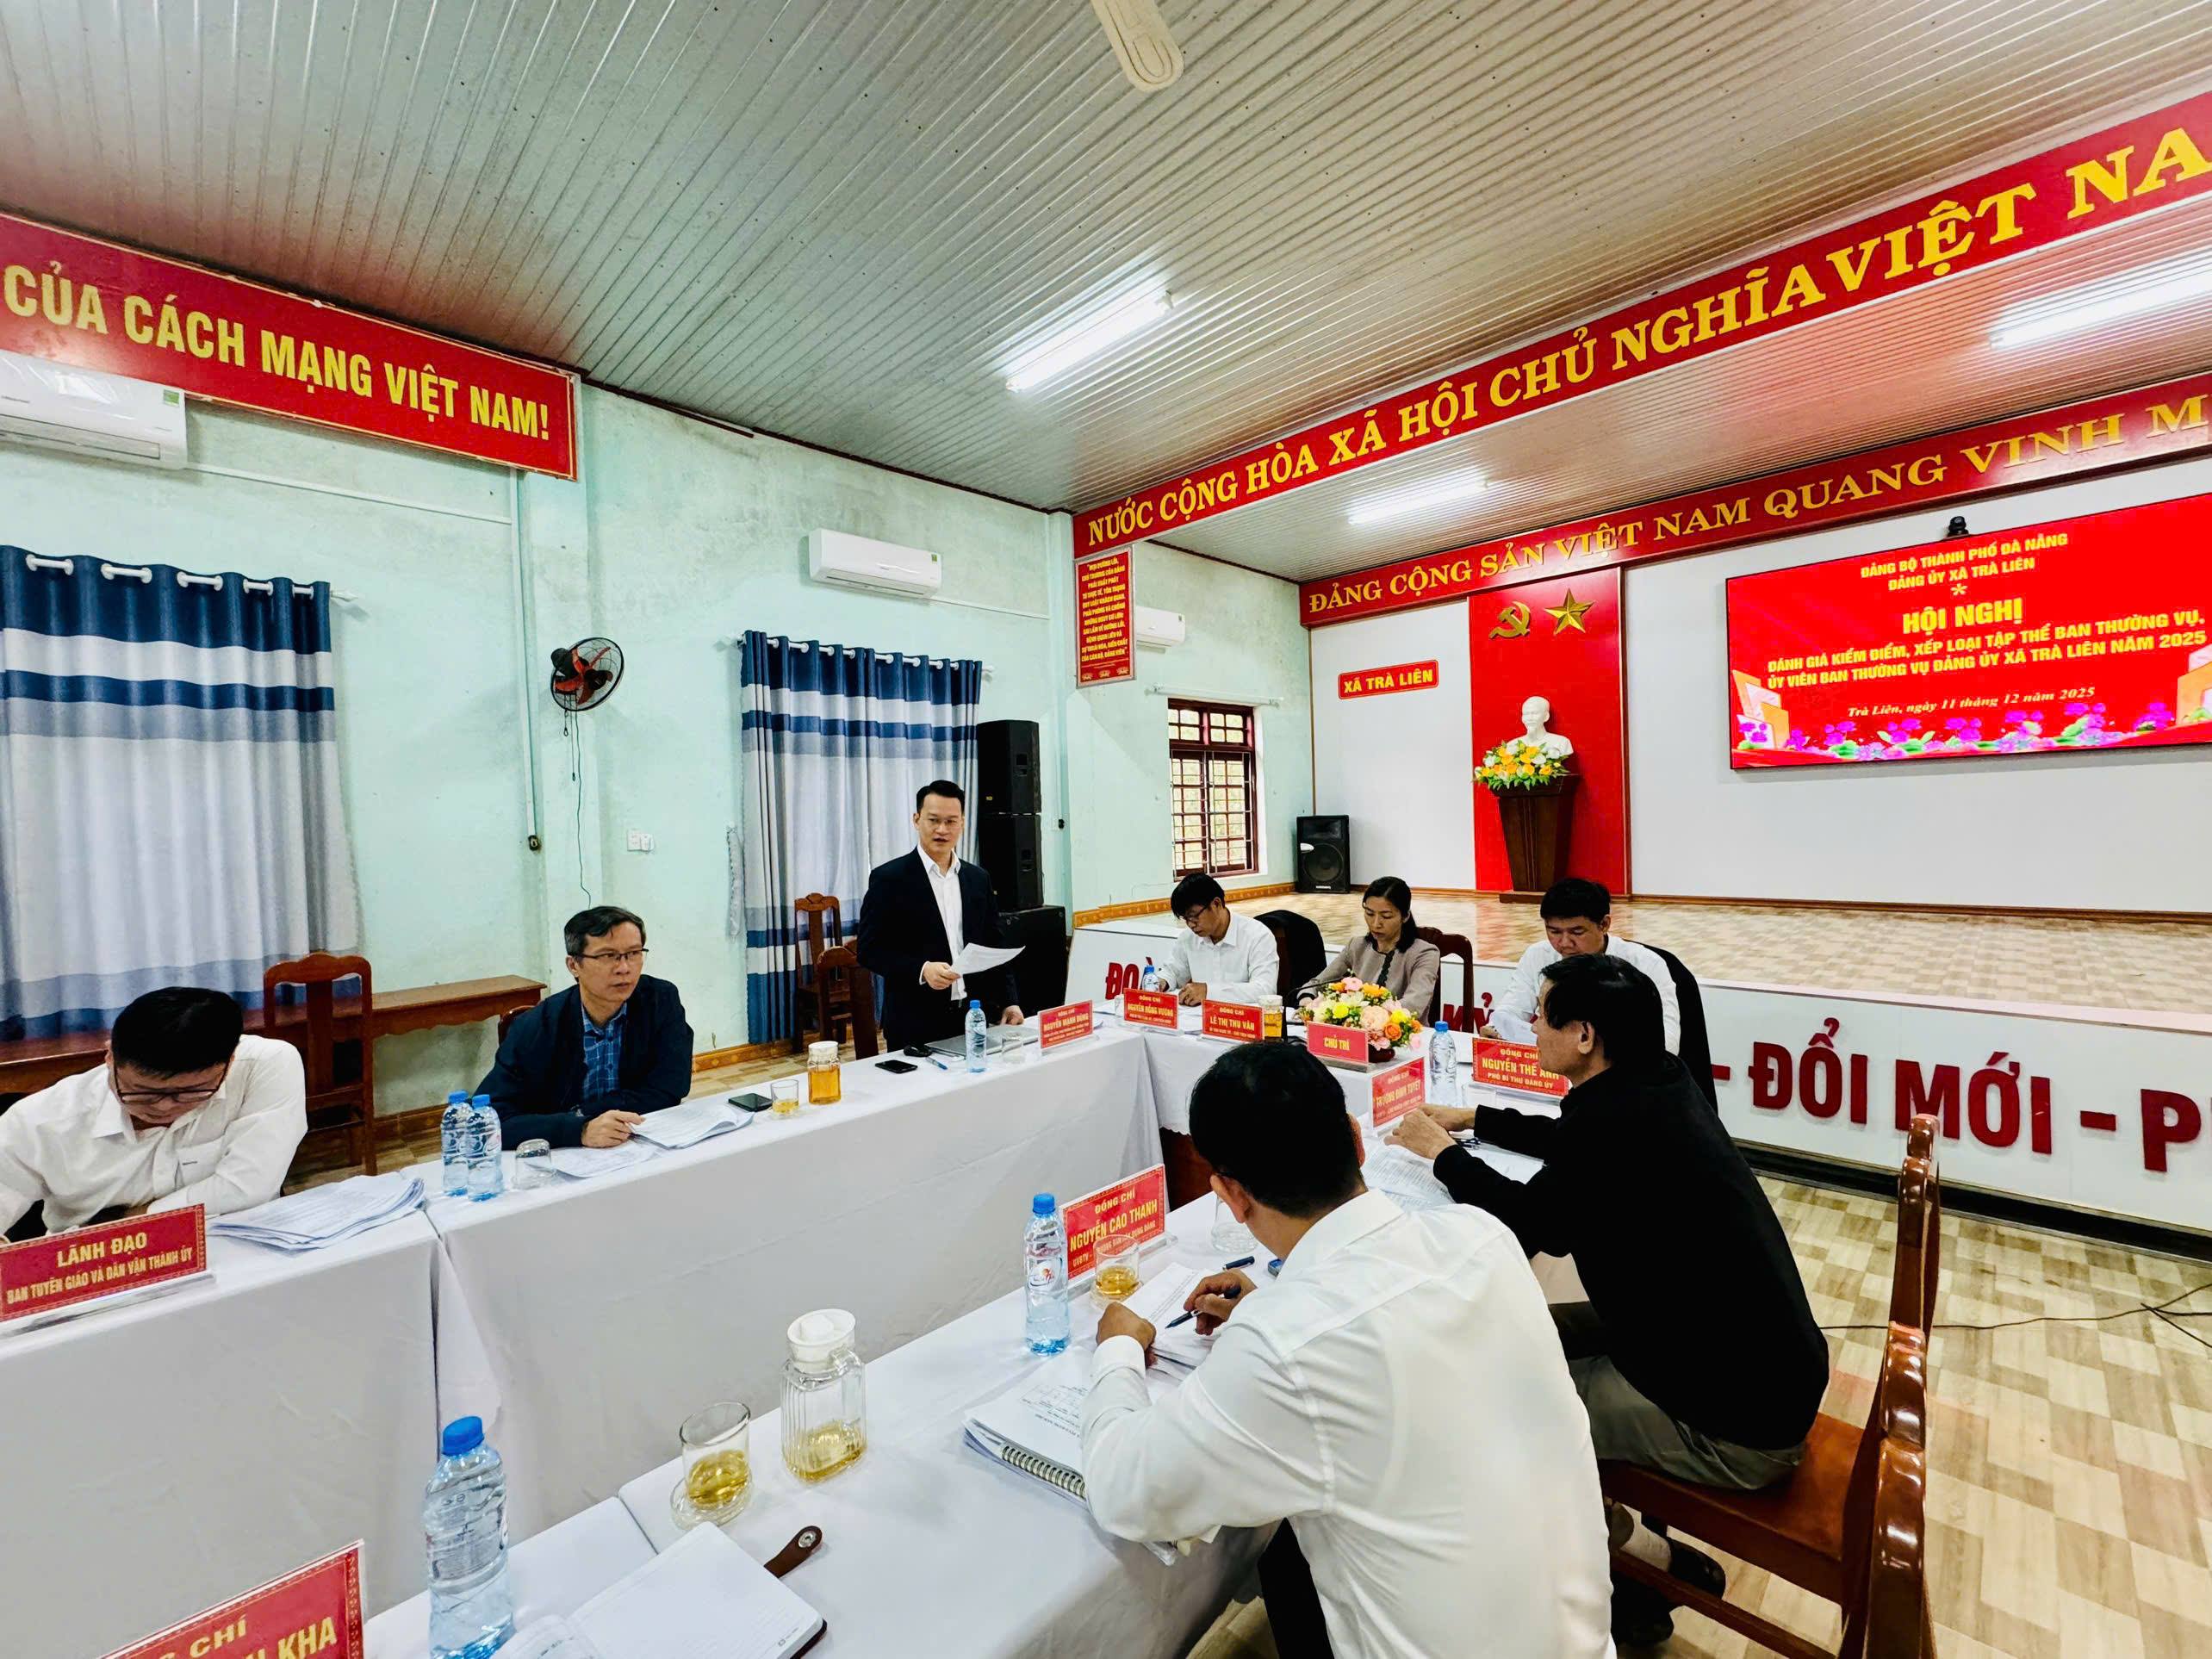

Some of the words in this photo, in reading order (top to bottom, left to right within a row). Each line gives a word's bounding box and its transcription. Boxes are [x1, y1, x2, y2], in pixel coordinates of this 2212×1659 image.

[4, 260, 109, 334] CỦA
[123, 294, 245, 367] CÁCH
[261, 329, 372, 396] MẠNG
[384, 363, 459, 422] VIỆT
[470, 387, 550, 440] NAM!
[1089, 498, 1153, 545] NƯỚC
[1160, 473, 1237, 520] CỘNG
[1246, 442, 1318, 492] HÒA
[1329, 410, 1386, 464] XÃ
[1399, 382, 1477, 440] HỘI
[1491, 326, 1596, 406] CHỦ
[1612, 265, 1827, 370] NGHĨA
[1826, 183, 2037, 292] VIỆT
[1309, 581, 1381, 613] ĐẢNG
[1390, 561, 1471, 594] CỘNG
[1480, 543, 1545, 579] SẢN
[1551, 521, 1643, 562] VIỆT
[1654, 497, 1750, 540] NAM
[1764, 455, 1948, 519] QUANG
[1960, 416, 2125, 475] VINH
[2145, 395, 2212, 438] M
[1861, 562, 1897, 578] ĐẢNG
[1898, 557, 1917, 572] BỘ
[1920, 551, 1966, 568] THÀNH
[1968, 541, 1998, 561] PHỐ
[2000, 539, 2022, 556] ĐÀ
[1888, 575, 1925, 591] ĐẢNG
[1928, 569, 1946, 585] ỦY
[1949, 566, 1968, 581] XÃ
[1971, 561, 1998, 578] TRÀ
[2001, 556, 2035, 573] LIÊN
[1903, 606, 1947, 636] HỘI
[1954, 598, 2022, 624] NGHỊ
[1768, 657, 1803, 673] ĐÁNH
[1805, 652, 1829, 668] GIÁ
[1832, 648, 1867, 665] KIỂM
[1914, 639, 1943, 656] XẾP
[1948, 636, 1981, 652] LOẠI
[1985, 631, 2016, 649] TẬP
[2020, 624, 2051, 643] THỂ
[2054, 624, 2091, 640] BAN
[2095, 614, 2169, 635] THƯỜNG
[1768, 674, 1785, 690] ỦY
[1787, 673, 1817, 687] VIÊN
[1820, 669, 1849, 684] BAN
[1851, 662, 1907, 680] THƯỜNG
[1910, 661, 1930, 675] VỤ
[1933, 656, 1976, 672] ĐẢNG
[1979, 651, 1999, 668] ỦY
[2004, 648, 2027, 665] XÃ
[2029, 644, 2063, 662] TRÀ
[2066, 641, 2107, 658] LIÊN
[2110, 636, 2155, 654] NĂM
[2159, 631, 2207, 649] 2025
[1343, 676, 1363, 695] XÃ
[1366, 673, 1395, 691] TRÀ
[1400, 668, 1433, 686] LIÊN
[1905, 701, 1937, 714] ngày
[1941, 699, 1956, 710] 11
[1960, 696, 1999, 711] tháng
[2004, 693, 2020, 704] 12
[2059, 687, 2096, 699] 2025
[1210, 1014, 1217, 1024] LÊ
[1218, 1017, 1228, 1028] THỊ
[1229, 1019, 1241, 1028] THU
[1324, 1034, 1338, 1049] CHỦ
[1482, 1057, 1517, 1073] NGUYỄN
[1748, 1017, 1868, 1125] ĐỔI
[1895, 1052, 2053, 1155] MỚI
[2141, 1089, 2212, 1171] P
[1095, 1199, 1118, 1215] ĐỒNG
[1121, 1187, 1135, 1202] CHÍ
[1070, 1219, 1107, 1252] NGUYỄN
[1109, 1213, 1128, 1233] CAO
[1129, 1199, 1158, 1224] THANH
[58, 1242, 105, 1268] LÃNH
[110, 1232, 147, 1255] ĐẠO
[30, 1277, 63, 1299] TUYÊN
[65, 1271, 90, 1290] GIÁO
[90, 1266, 105, 1283] VÀ
[106, 1262, 126, 1281] DÂN
[127, 1258, 146, 1277] VẬN
[148, 1251, 179, 1270] THÀNH
[180, 1246, 193, 1263] ỦY
[189, 1614, 246, 1658] CHÍ
[277, 1616, 338, 1659] KHA
